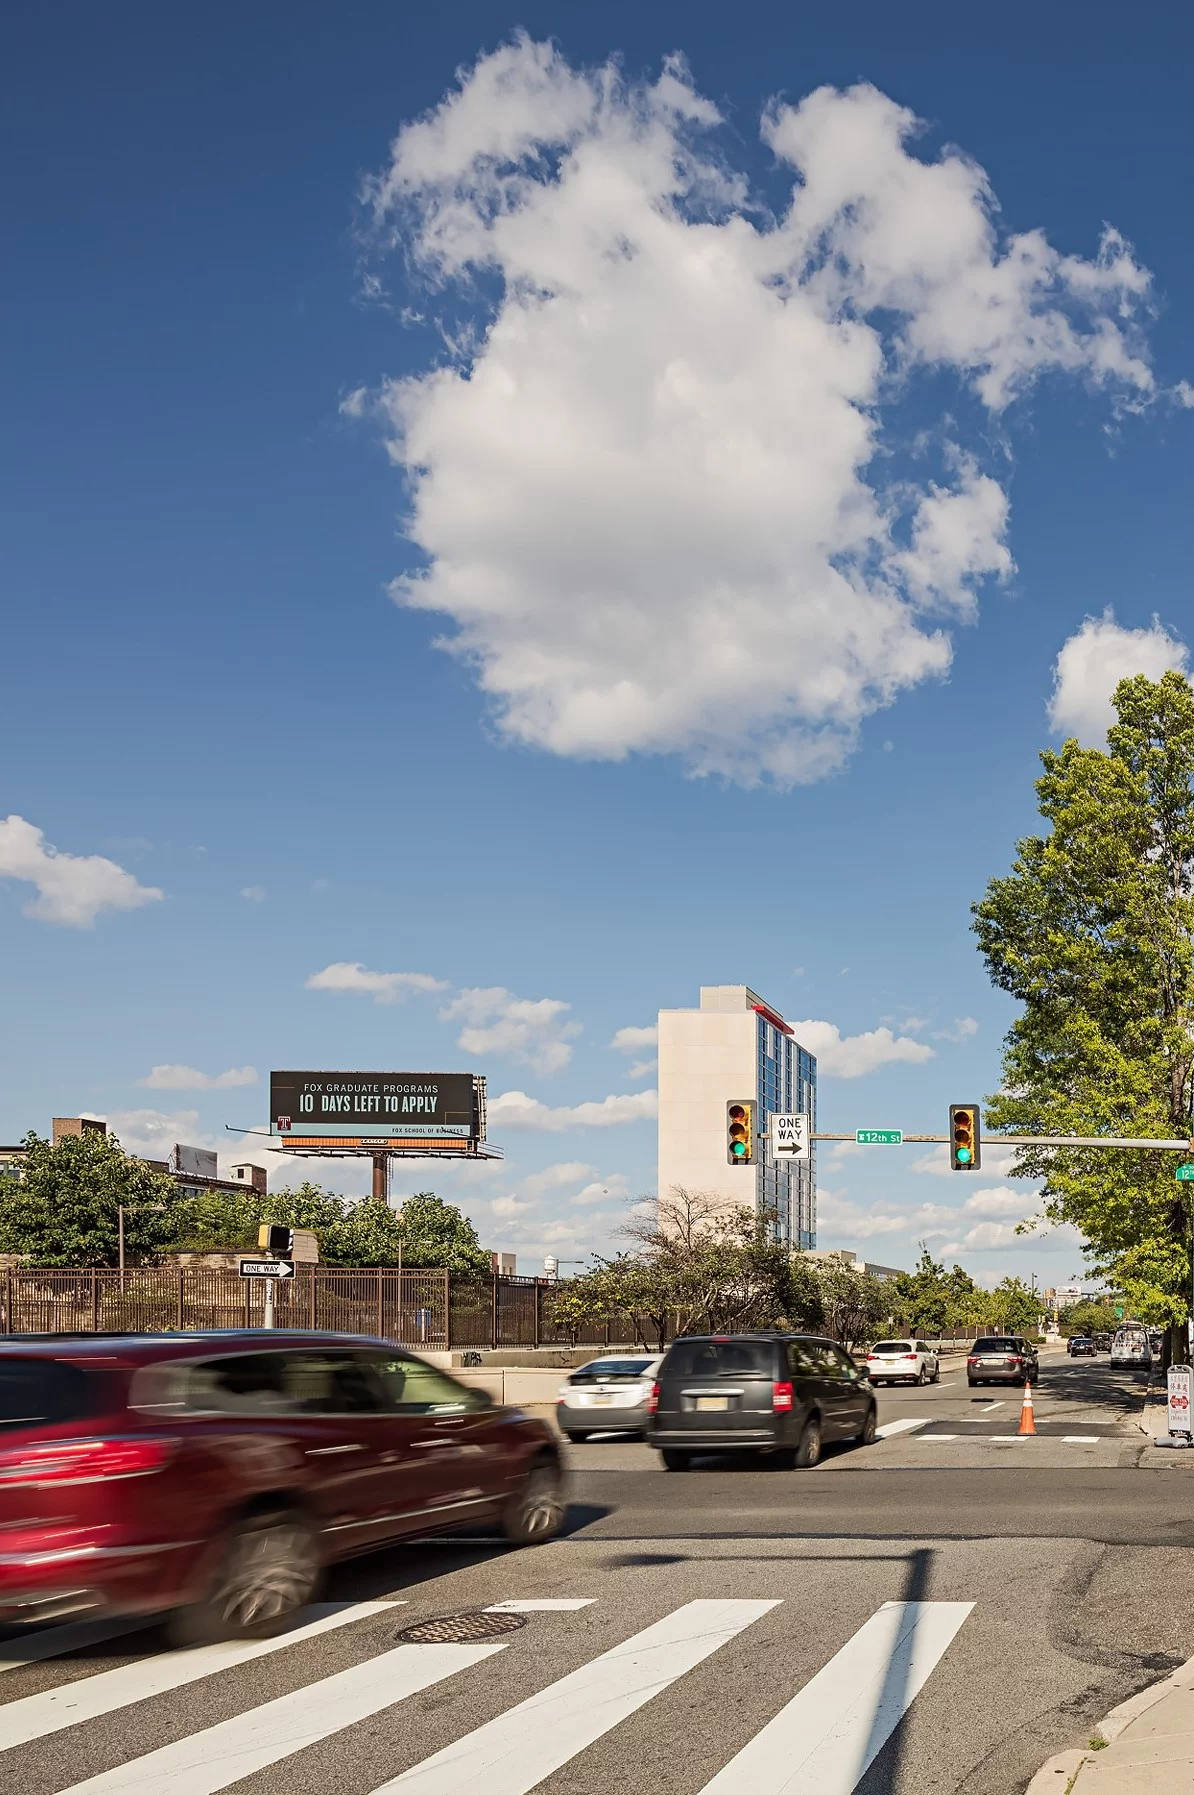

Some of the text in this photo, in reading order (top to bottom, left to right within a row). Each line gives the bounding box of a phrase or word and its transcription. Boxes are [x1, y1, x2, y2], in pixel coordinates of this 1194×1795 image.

[304, 1084, 438, 1093] FOX GRADUATE PROGRAMS
[299, 1094, 437, 1113] 10 DAYS LEFT TO APPLY
[778, 1118, 801, 1128] ONE
[778, 1130, 802, 1139] WAY
[866, 1132, 900, 1142] 12th St
[264, 1265, 279, 1273] WAY
